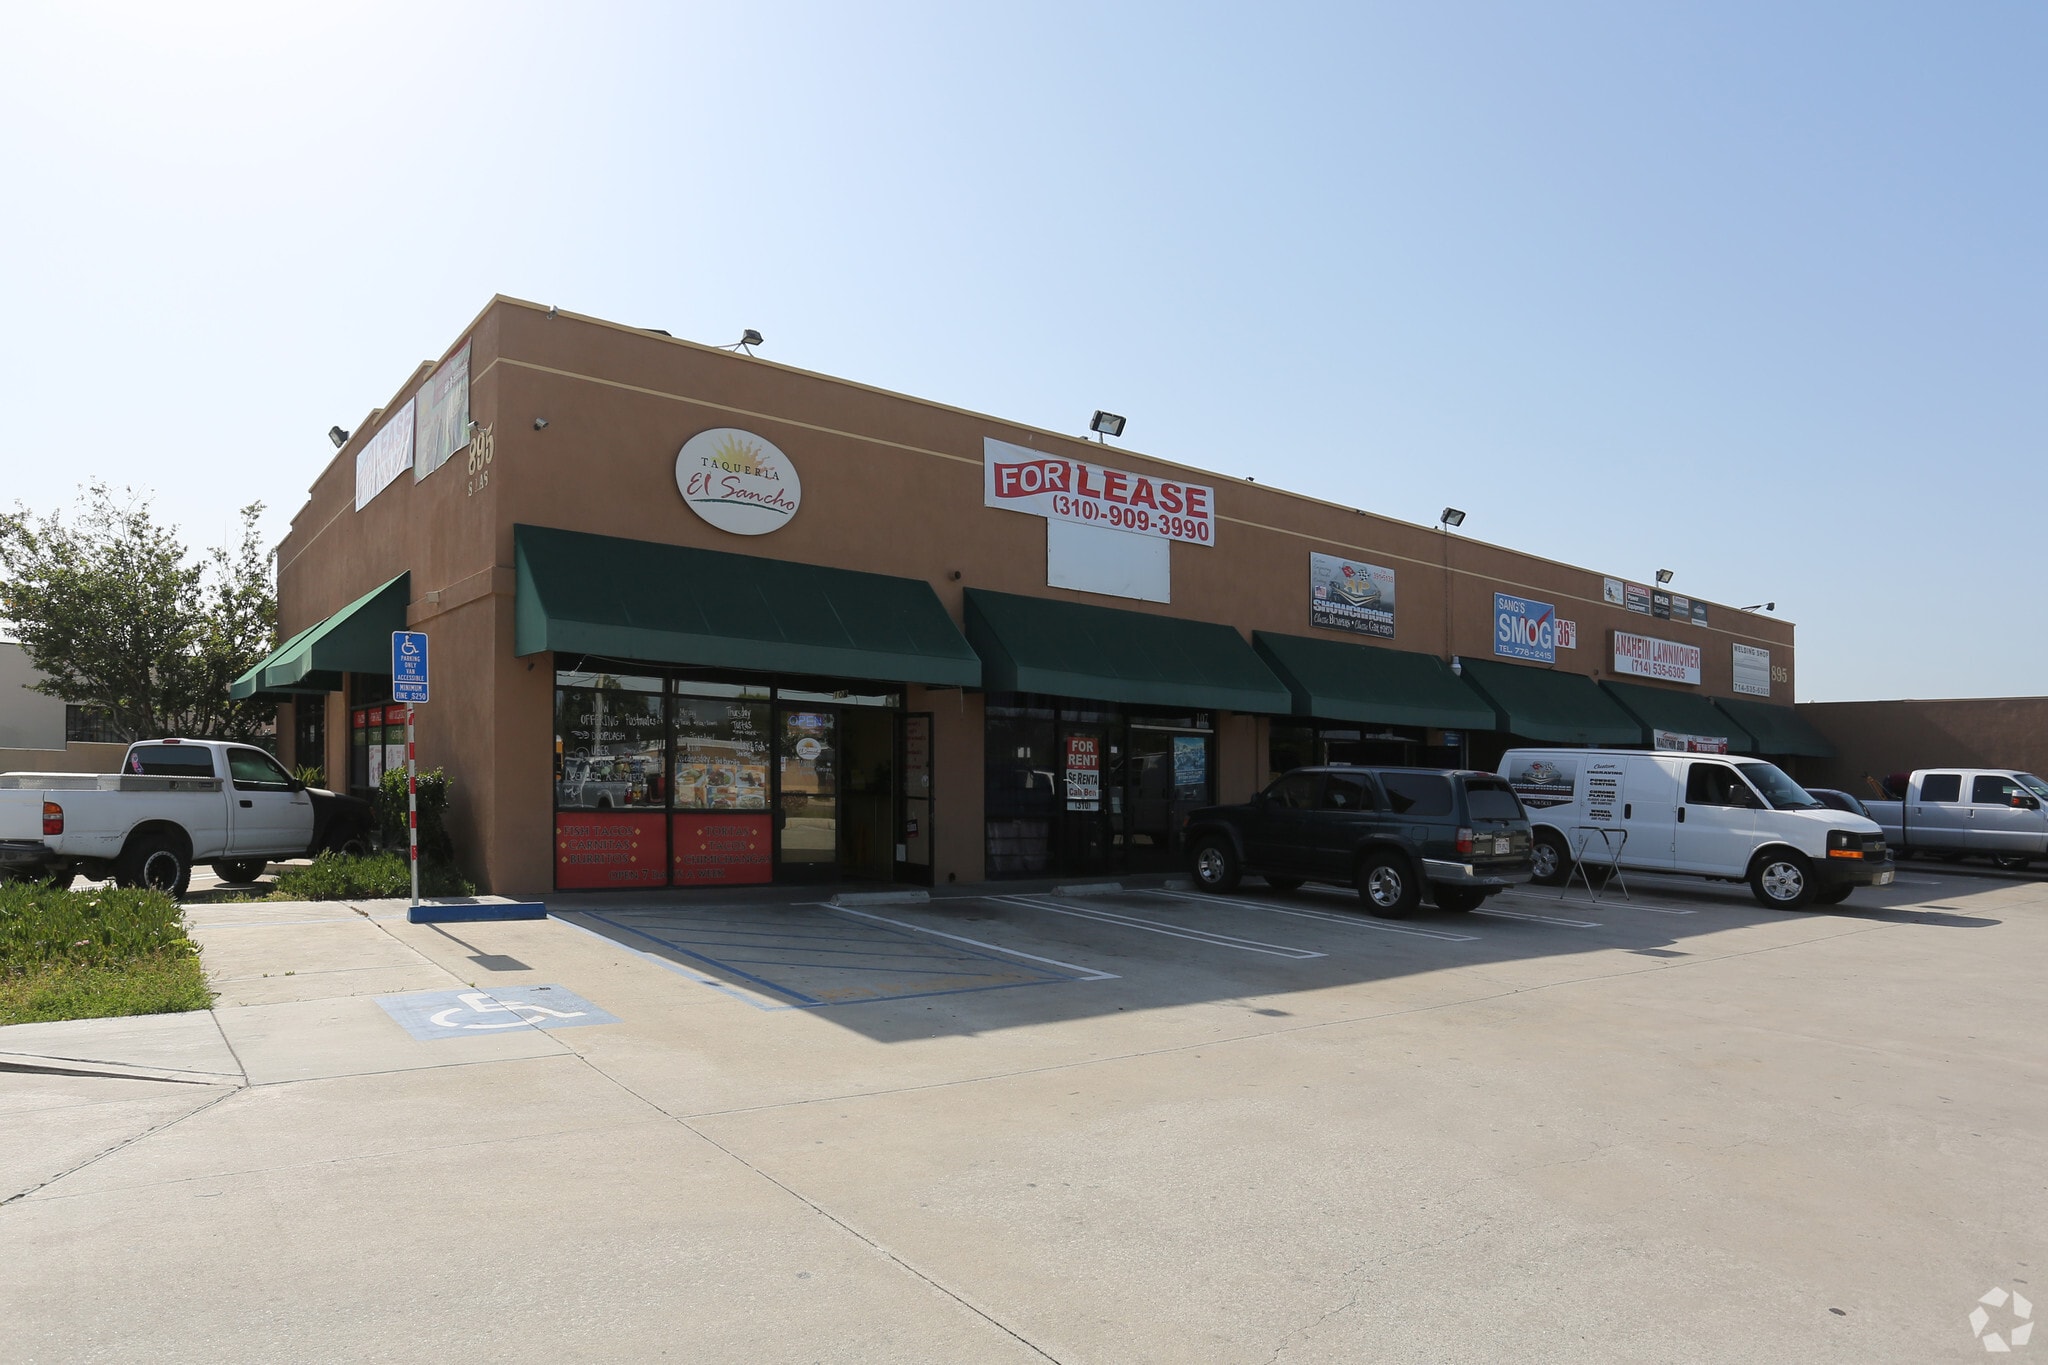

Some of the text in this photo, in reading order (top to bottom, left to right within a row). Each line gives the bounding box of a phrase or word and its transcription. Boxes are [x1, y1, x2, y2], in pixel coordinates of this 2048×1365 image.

[469, 422, 494, 475] 895
[701, 457, 779, 480] TAQUERIA
[687, 471, 795, 510] El Sancho
[1001, 462, 1208, 519] FOR LEASE
[1053, 495, 1209, 541] (310)-909-3990
[1313, 599, 1394, 624] SHOWCHROME
[1499, 598, 1525, 613] SANG'S
[1499, 614, 1552, 649] SMOG
[1499, 644, 1551, 659] TEL. 778-2415
[1616, 634, 1699, 669] ANAHEIM LAWNMOWER
[1632, 659, 1685, 679] (714) 535-6305
[1771, 665, 1788, 683] 895
[400, 684, 422, 692] MINIMUM
[411, 692, 426, 700] $250
[592, 701, 609, 712] NW
[788, 715, 823, 726] OPEN
[591, 731, 626, 741] DORDASH
[1072, 740, 1093, 753] FOR
[1068, 753, 1097, 766] RENT
[1068, 772, 1098, 785] SE RENTA
[563, 826, 634, 836] FISH TACOS
[705, 826, 749, 837] TORTAS
[568, 839, 630, 850] CARNITAS
[708, 840, 746, 850] TACOS
[570, 853, 630, 864] BURRITOS
[684, 854, 772, 864] CHIMICHANGAS
[608, 870, 638, 880] OPEN
[642, 869, 649, 880] 7
[697, 868, 725, 878] WEEK
